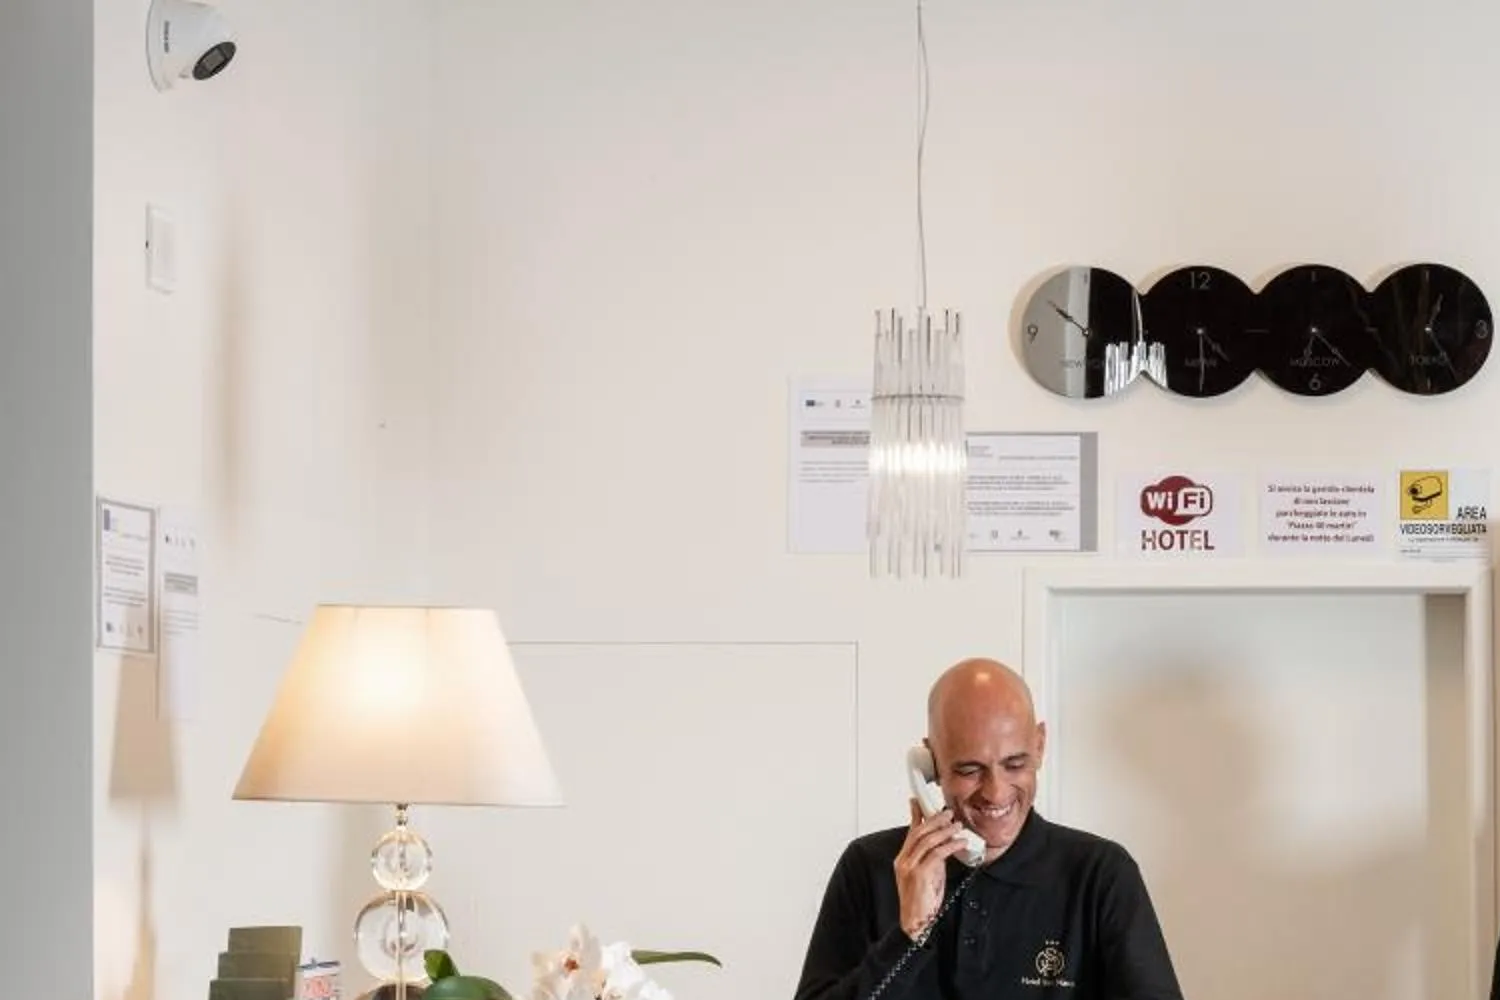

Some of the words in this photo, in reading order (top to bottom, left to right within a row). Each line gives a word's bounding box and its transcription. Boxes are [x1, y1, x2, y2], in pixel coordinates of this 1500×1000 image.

[1189, 271, 1212, 290] 12
[1027, 324, 1039, 344] 9
[1456, 506, 1487, 520] AREA
[1141, 529, 1216, 551] HOTEL
